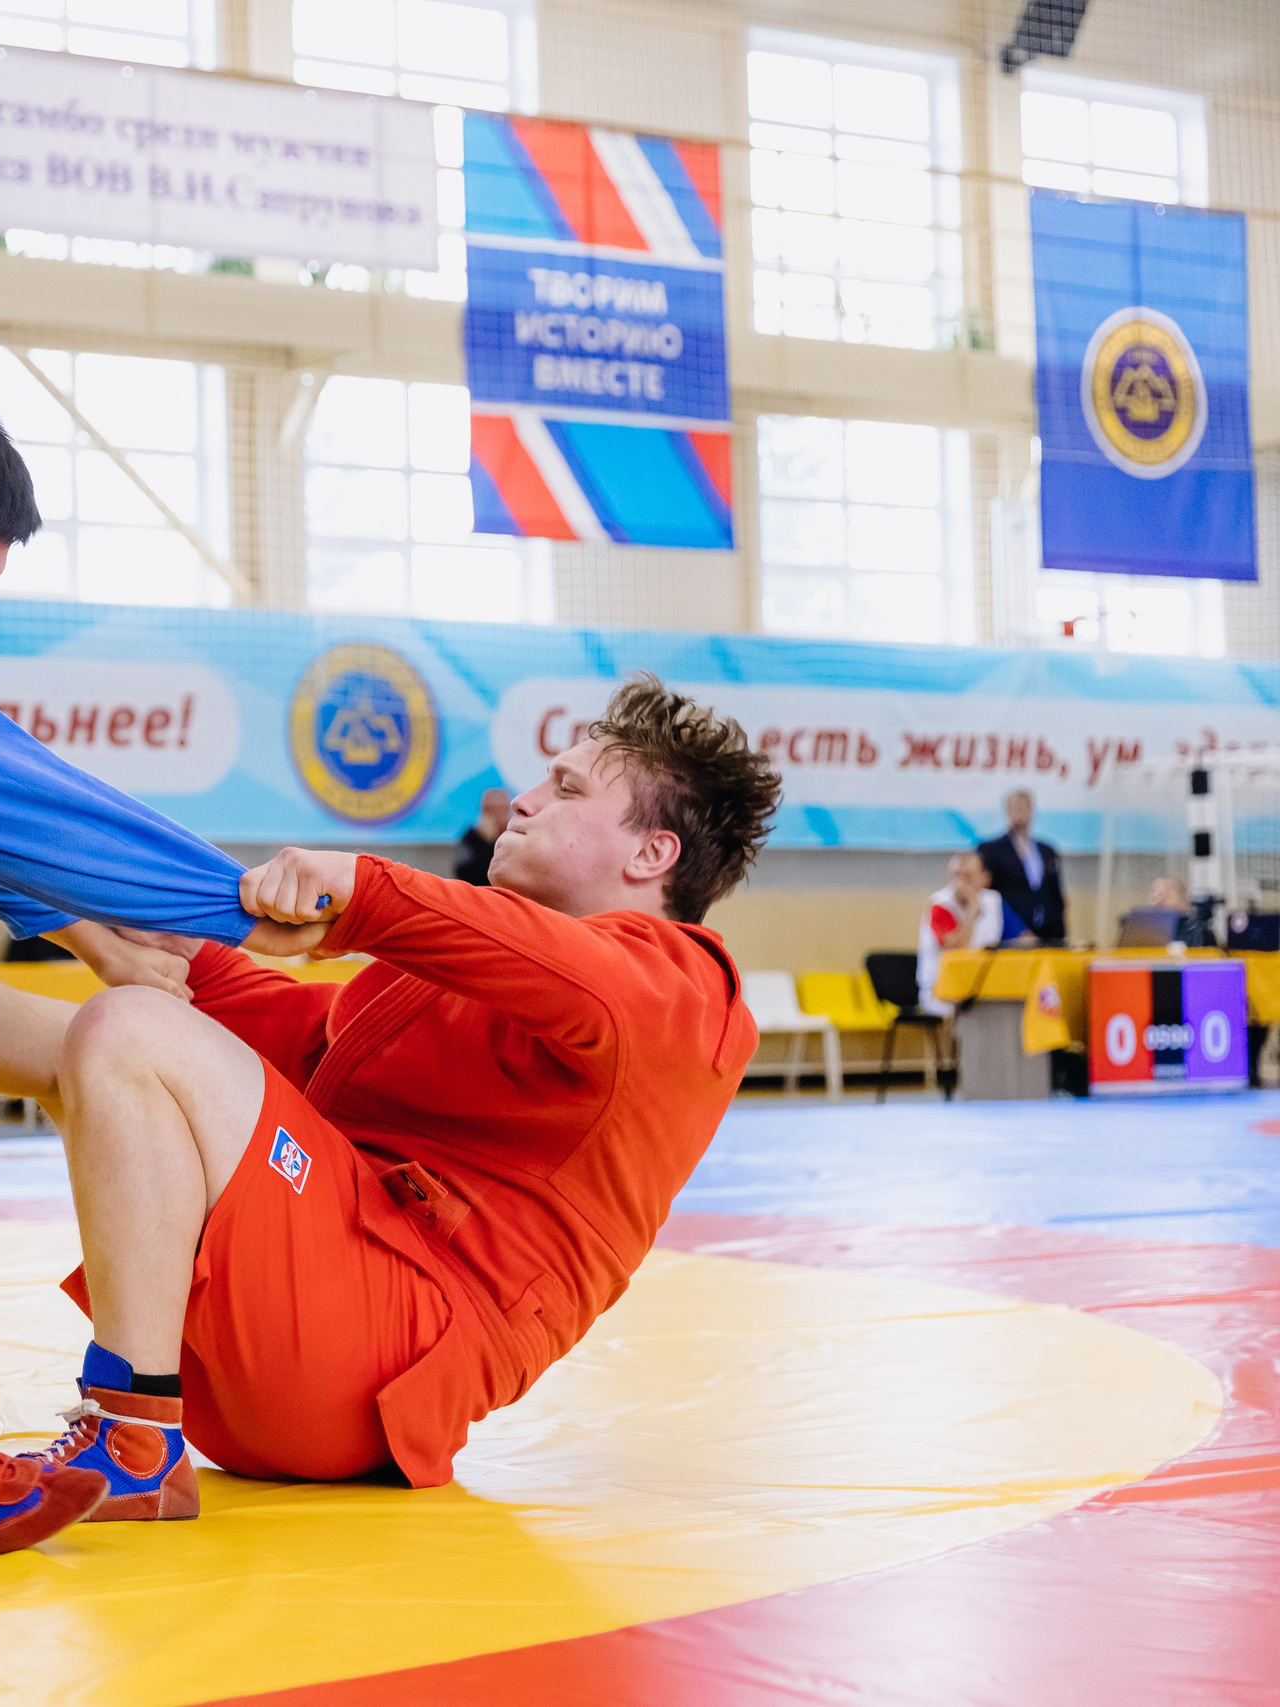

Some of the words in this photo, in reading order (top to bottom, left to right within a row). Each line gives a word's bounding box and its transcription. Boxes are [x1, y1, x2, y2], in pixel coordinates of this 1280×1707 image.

[114, 116, 219, 150] среди
[46, 151, 133, 194] ВОВ
[528, 267, 668, 317] ТВОРИМ
[514, 311, 684, 360] ИСТОРИЮ
[532, 354, 665, 400] ВМЕСТЕ
[758, 727, 878, 768] есть
[897, 731, 1068, 778] жизнь,
[1106, 1013, 1137, 1067] 0
[1200, 1010, 1231, 1063] 0
